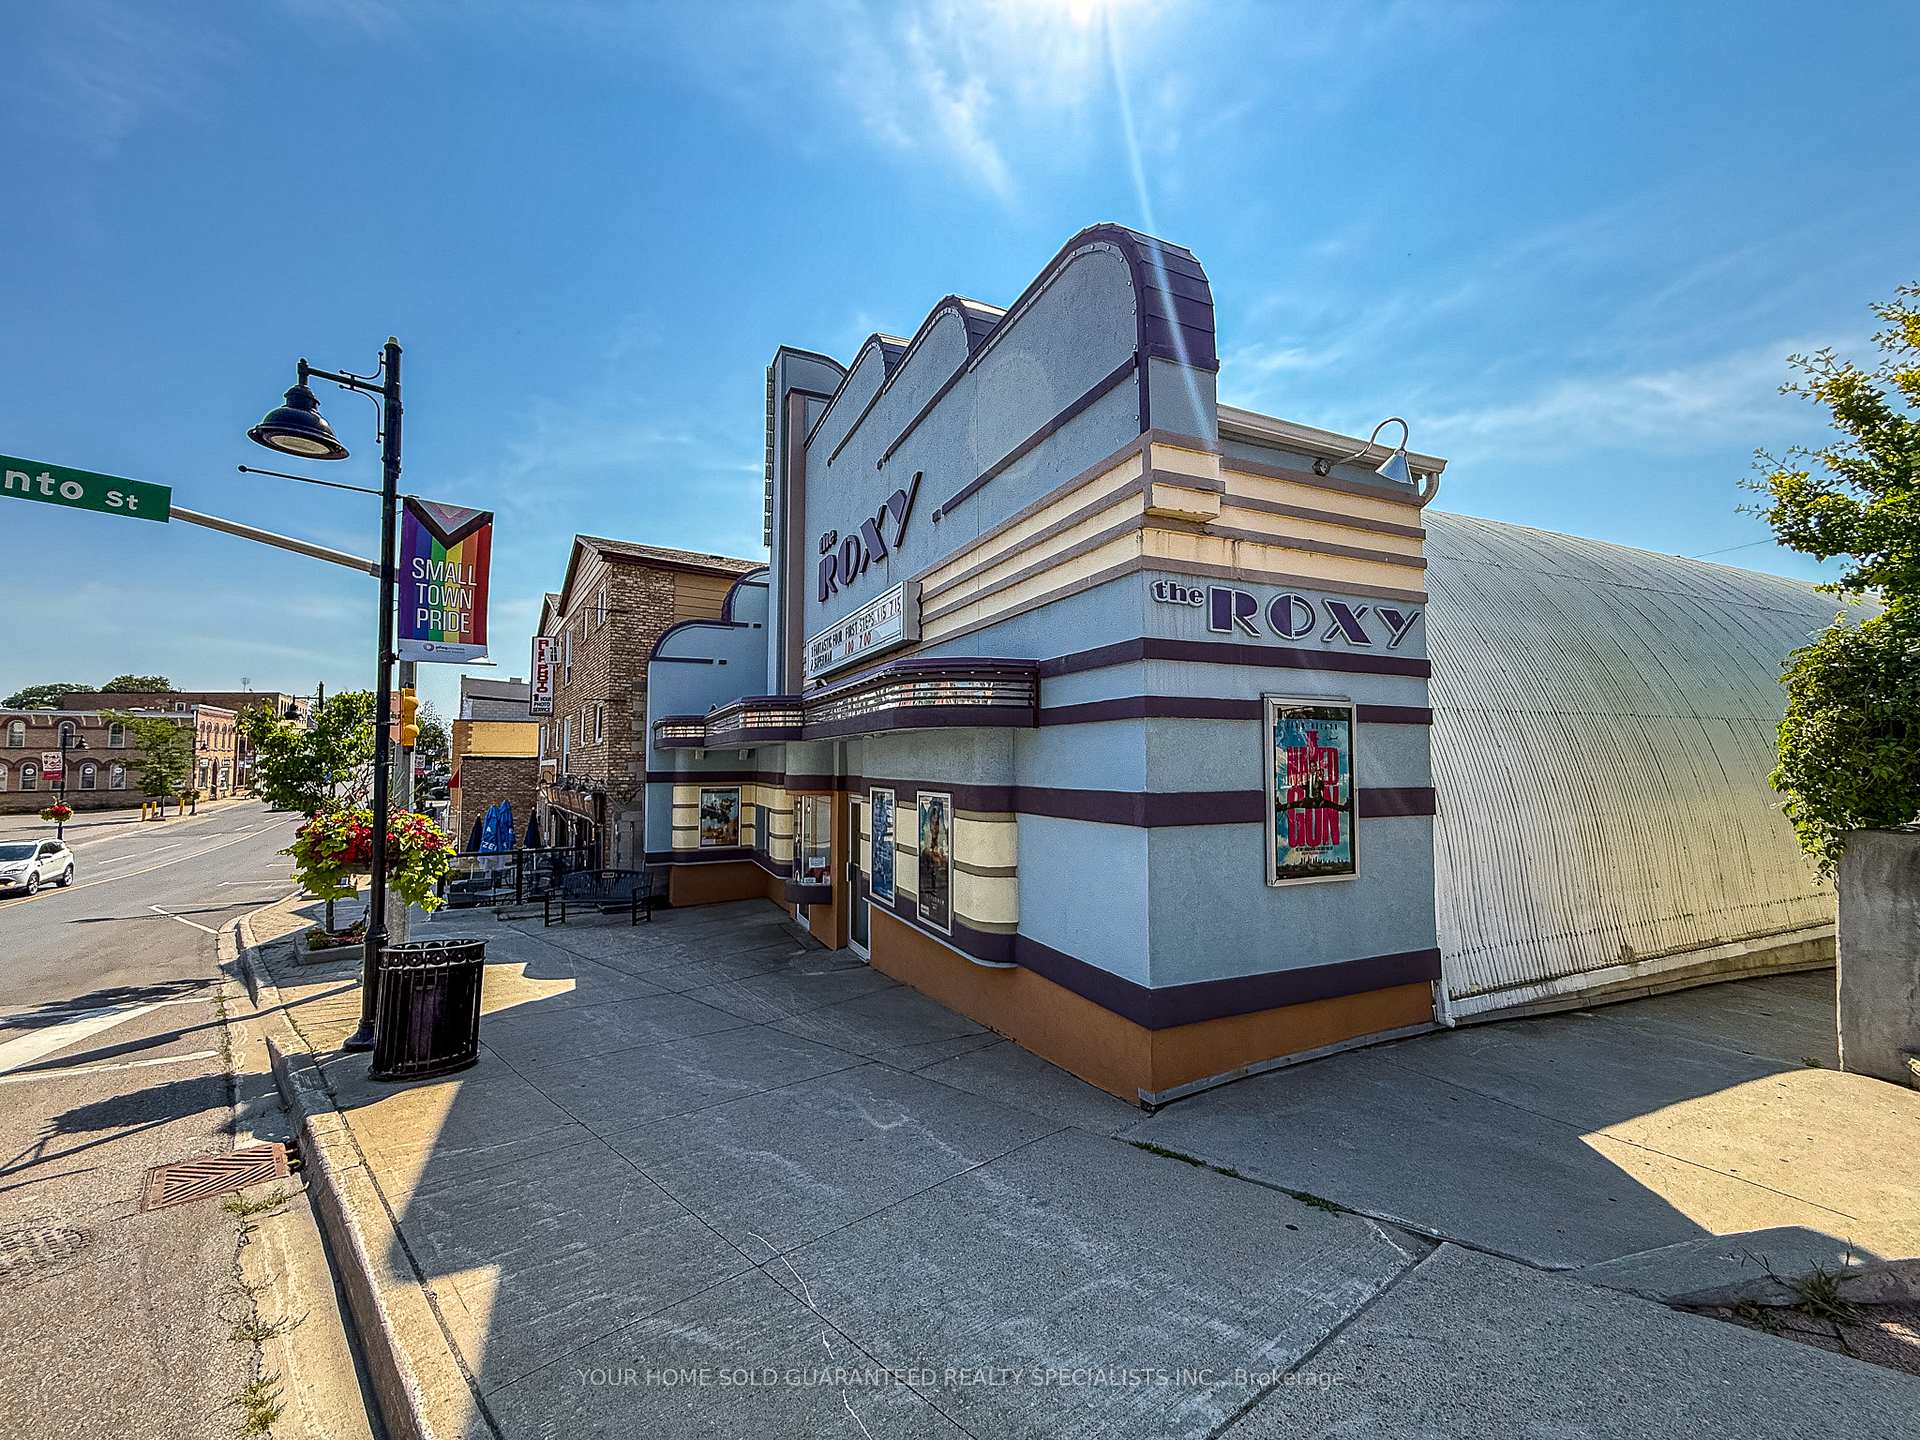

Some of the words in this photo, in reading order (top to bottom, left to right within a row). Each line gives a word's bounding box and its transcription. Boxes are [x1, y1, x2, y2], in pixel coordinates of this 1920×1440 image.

[818, 471, 923, 603] ROXY
[411, 557, 477, 586] SMALL
[415, 583, 472, 610] TOWN
[416, 608, 470, 633] PRIDE
[1151, 578, 1204, 607] the
[1207, 585, 1422, 649] ROXY
